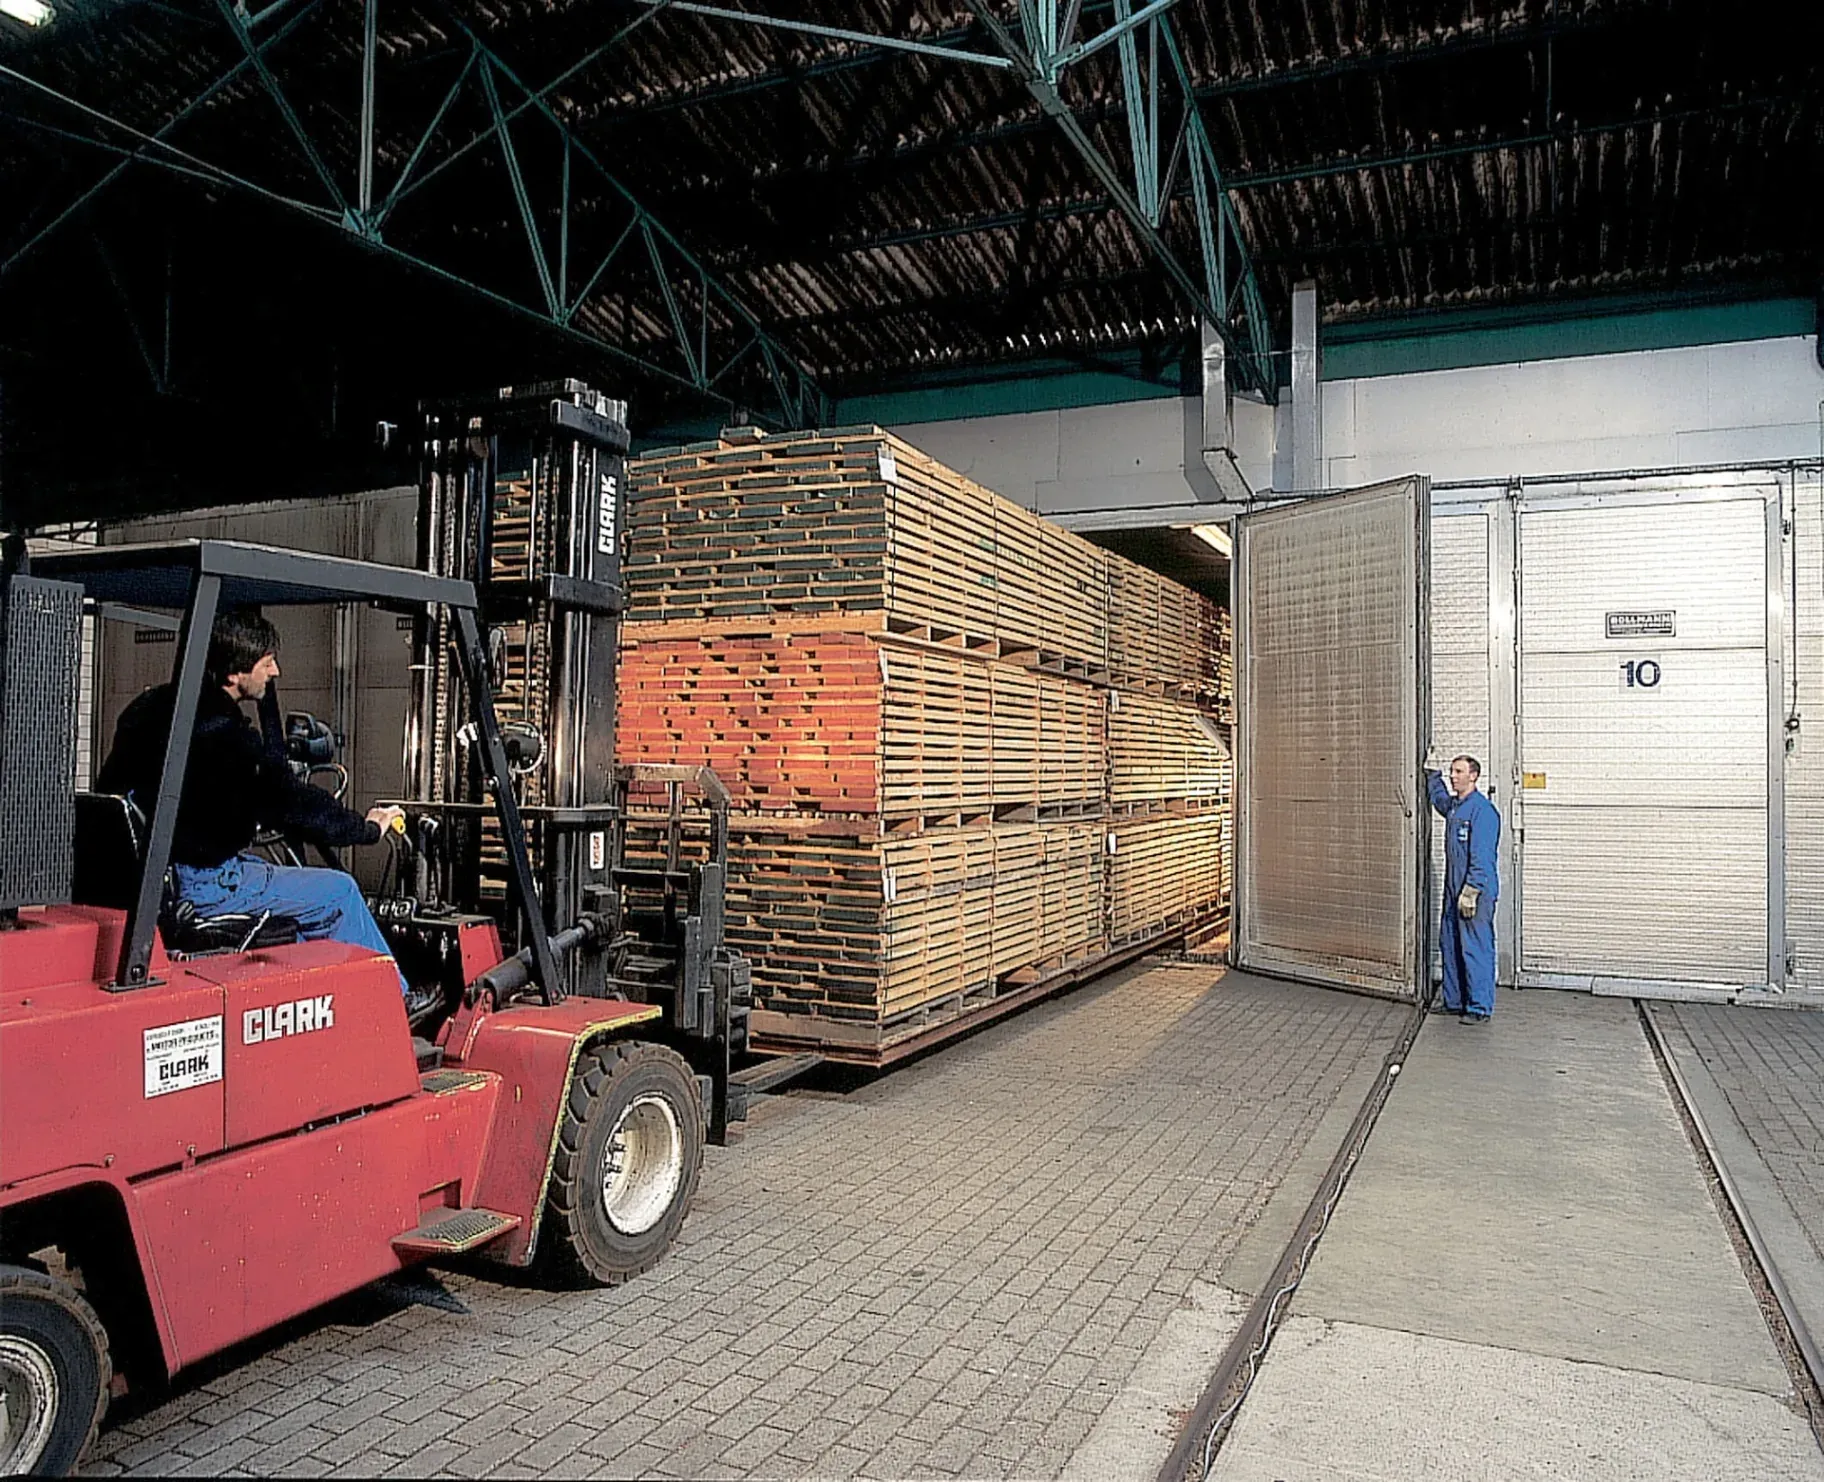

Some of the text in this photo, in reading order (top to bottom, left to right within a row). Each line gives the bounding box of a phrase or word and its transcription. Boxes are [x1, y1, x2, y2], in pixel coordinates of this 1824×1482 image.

[598, 473, 617, 555] CLARK
[1620, 660, 1660, 687] 10
[243, 994, 334, 1045] CLARK
[159, 1054, 209, 1081] CLARK
